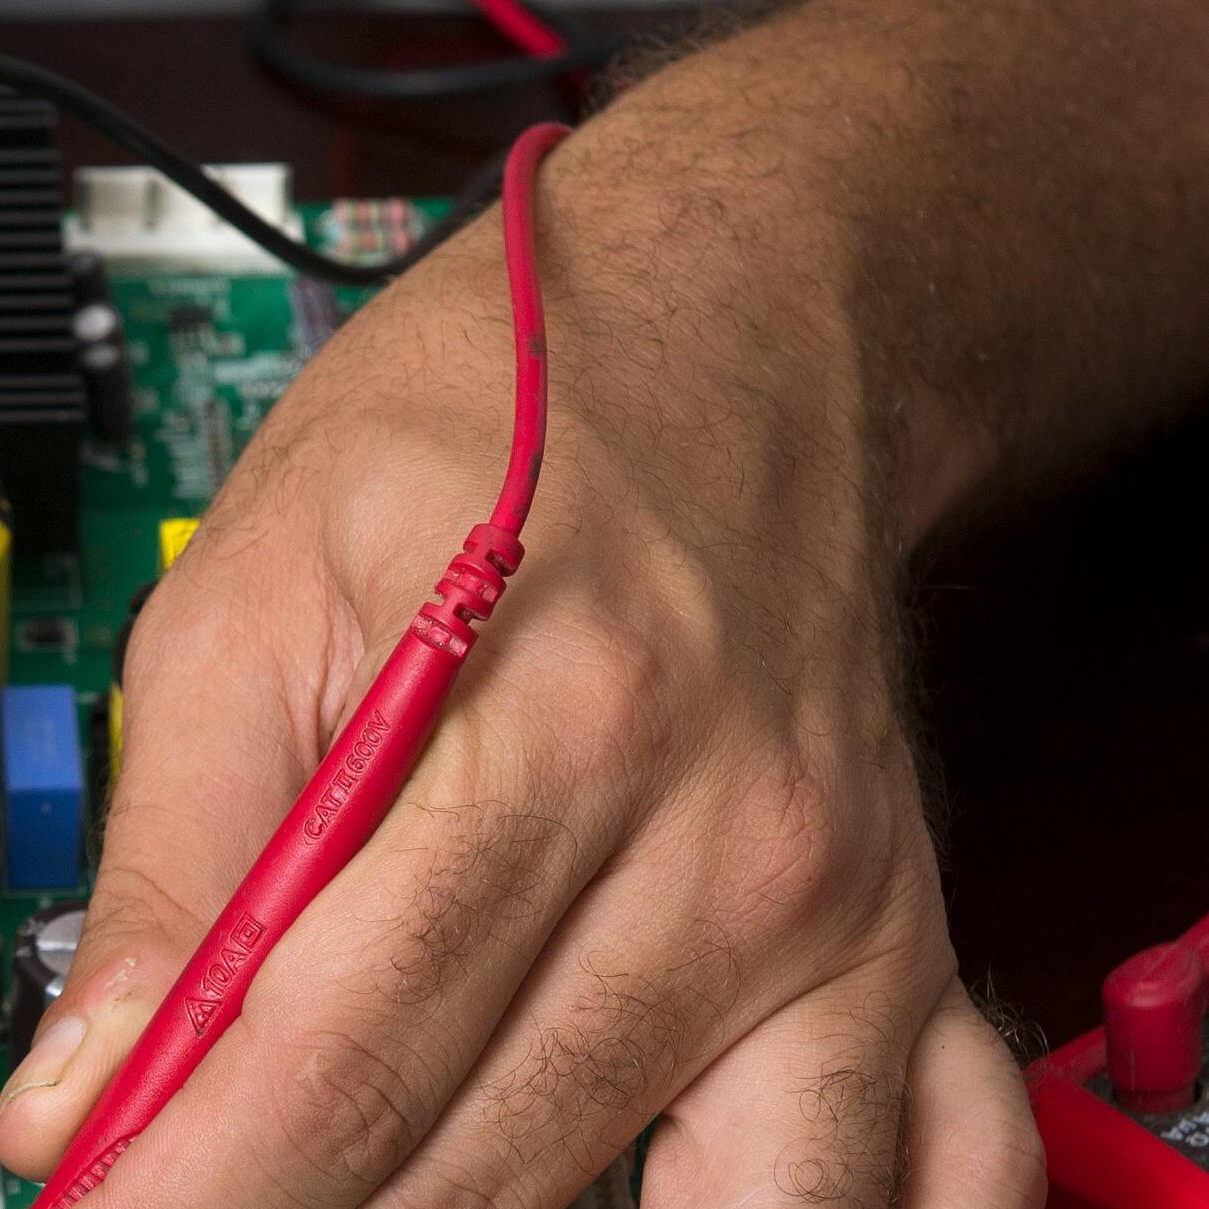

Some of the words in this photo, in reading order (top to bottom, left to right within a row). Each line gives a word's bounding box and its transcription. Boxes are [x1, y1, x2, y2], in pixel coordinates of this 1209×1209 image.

[304, 794, 346, 843] CAT
[350, 711, 392, 775] 600V
[202, 945, 250, 997] 10A
